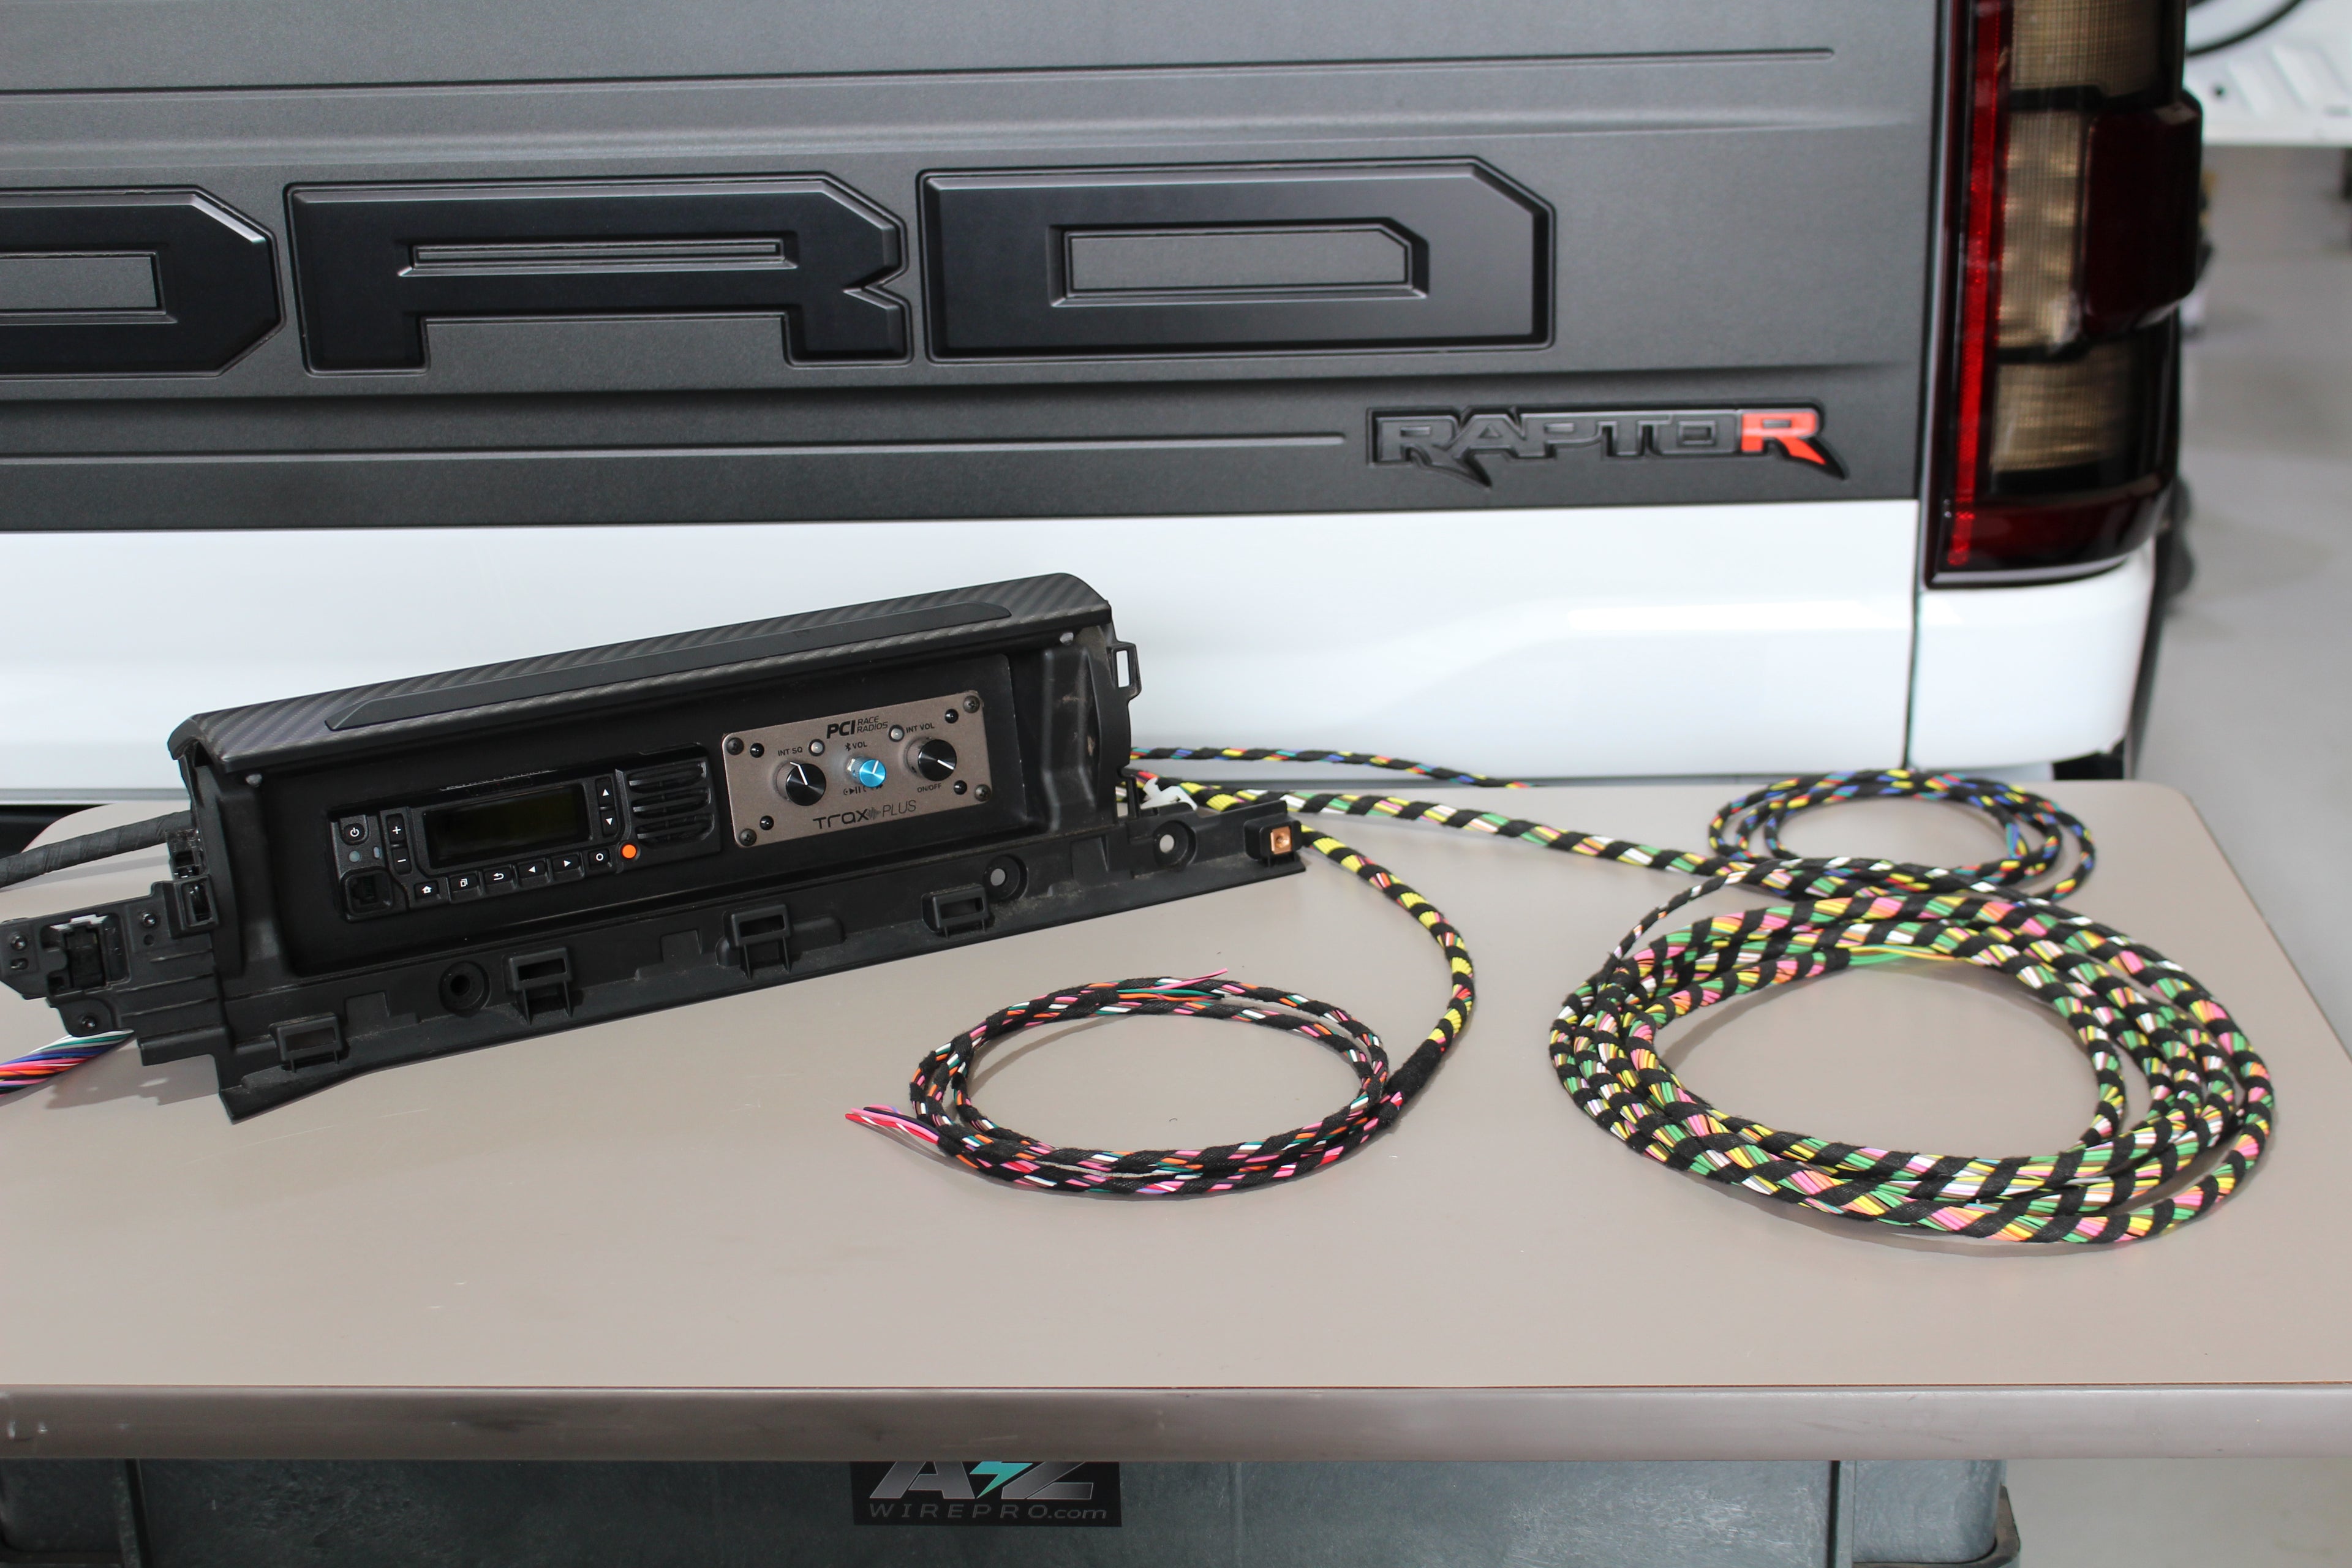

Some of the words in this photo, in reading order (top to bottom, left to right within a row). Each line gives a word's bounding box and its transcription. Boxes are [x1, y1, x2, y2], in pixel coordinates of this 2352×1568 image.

[1368, 407, 1849, 488] RAPTOR
[857, 715, 880, 725] RACE
[826, 720, 856, 739] PCI
[857, 721, 888, 733] RADIOS
[906, 725, 918, 733] INT
[920, 722, 935, 731] VOL
[853, 741, 867, 750] VOL
[917, 783, 941, 793] ON/OFF
[881, 800, 916, 818] PLUS
[869, 1504, 1106, 1519] WIREPRO.com
